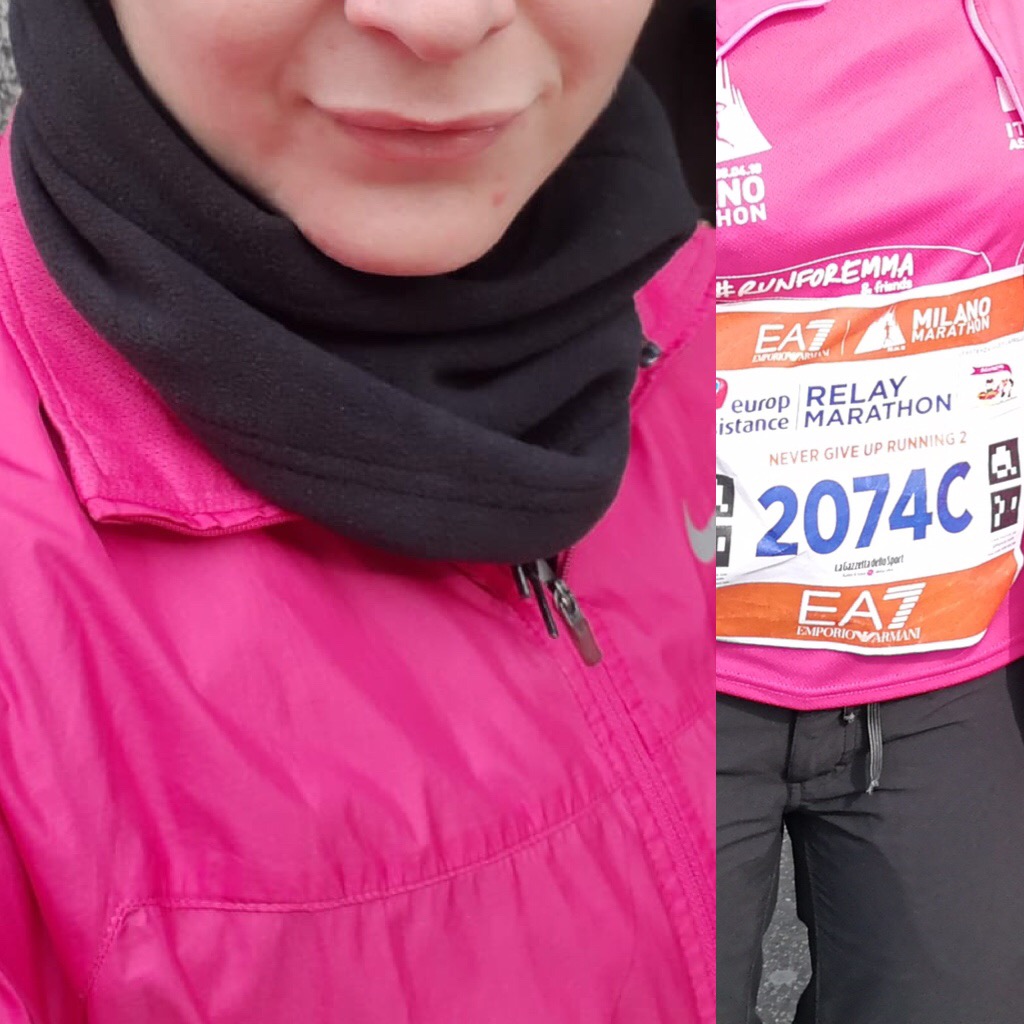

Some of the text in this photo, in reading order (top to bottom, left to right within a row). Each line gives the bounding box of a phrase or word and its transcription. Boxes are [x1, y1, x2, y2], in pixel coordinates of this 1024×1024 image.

[911, 315, 990, 343] MARATHON
[912, 296, 991, 329] MILANO
[755, 318, 836, 354] EA7
[731, 395, 790, 415] europ
[806, 376, 907, 407] RELAY
[716, 417, 789, 436] istance
[804, 393, 952, 428] MARATHON
[769, 430, 967, 466] NEVER GIVE UP RUNNING 2
[755, 461, 973, 558] 2074C
[798, 582, 927, 630] EA7
[797, 626, 921, 643] EMPORIO ARMANI
